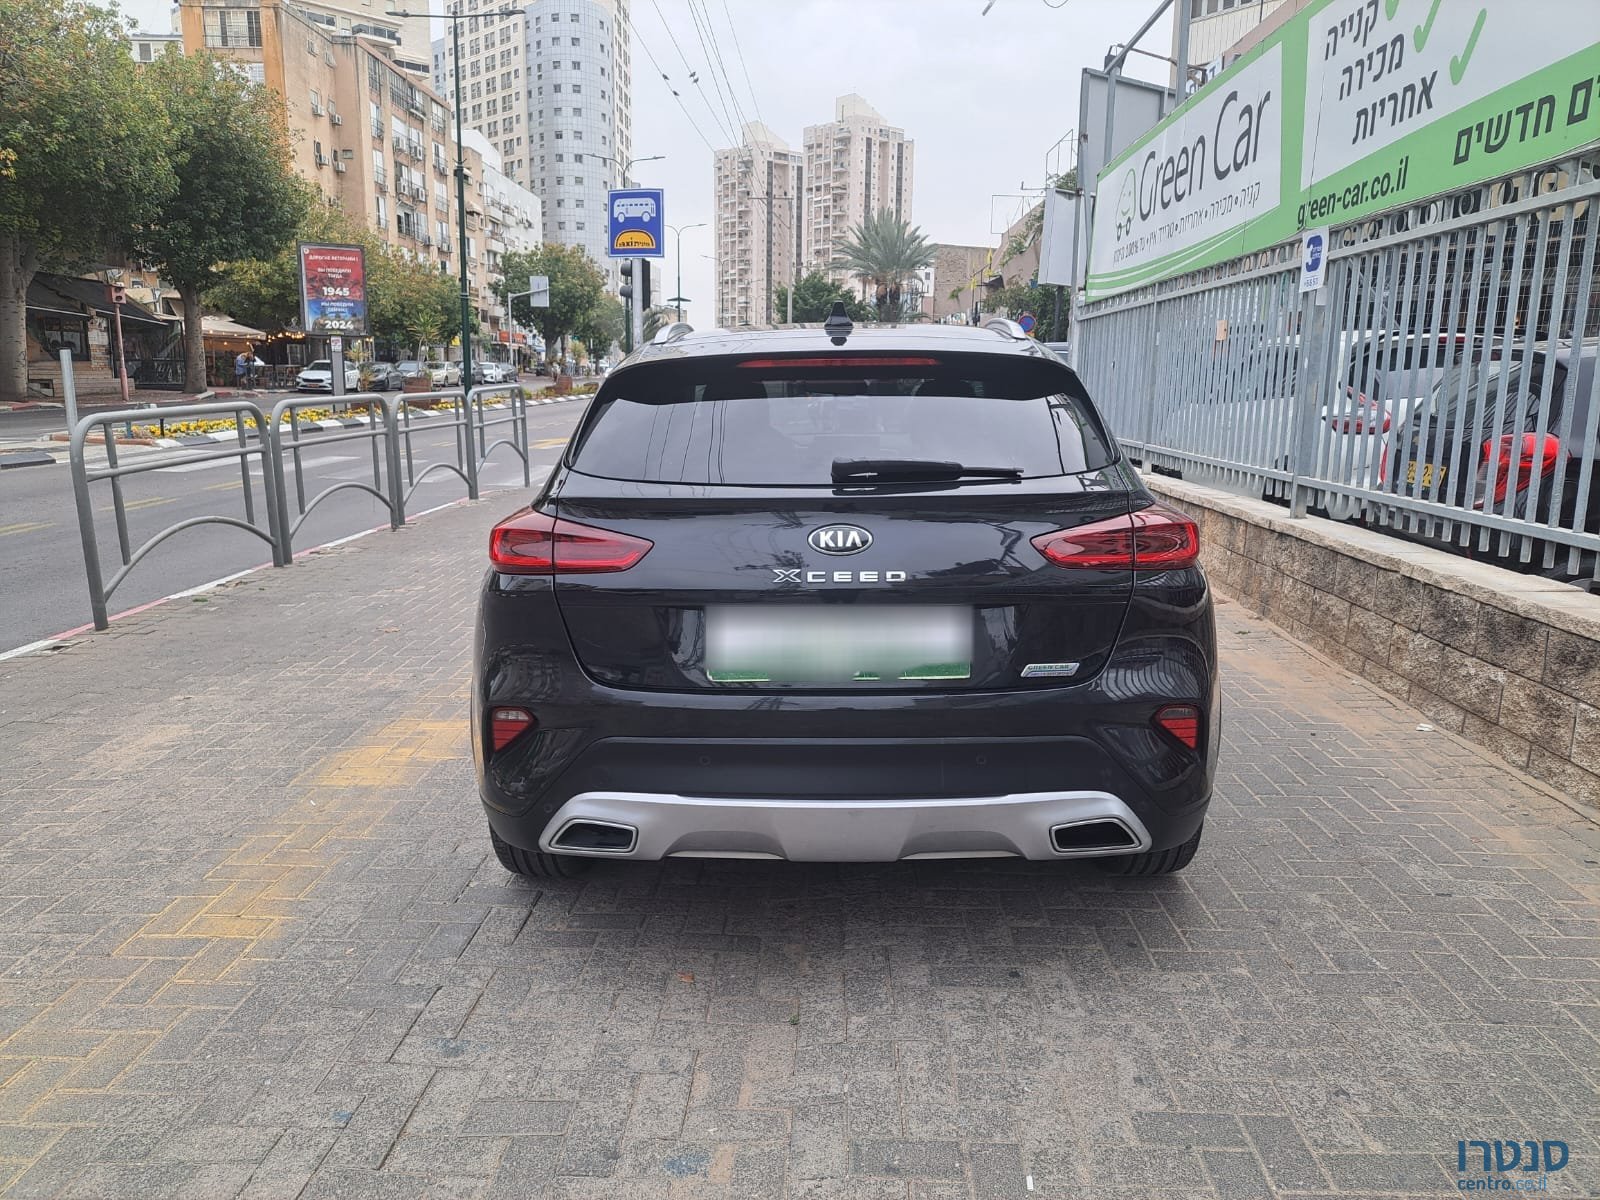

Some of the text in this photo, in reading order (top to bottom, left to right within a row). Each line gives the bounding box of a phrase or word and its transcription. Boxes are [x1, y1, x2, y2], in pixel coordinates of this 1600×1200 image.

[1325, 0, 1379, 60] קנייה
[1339, 34, 1405, 101] מכירה
[1352, 70, 1438, 145] אחריות
[1453, 95, 1556, 166] חדשים
[1139, 90, 1271, 221] Green Car
[1209, 195, 1233, 221] מכירה
[1240, 182, 1261, 208] קניה
[1178, 209, 1204, 235] אחריות
[322, 286, 350, 296] 1945
[324, 320, 354, 329] 2024
[819, 530, 863, 548] KIA
[772, 569, 907, 583] XCEED
